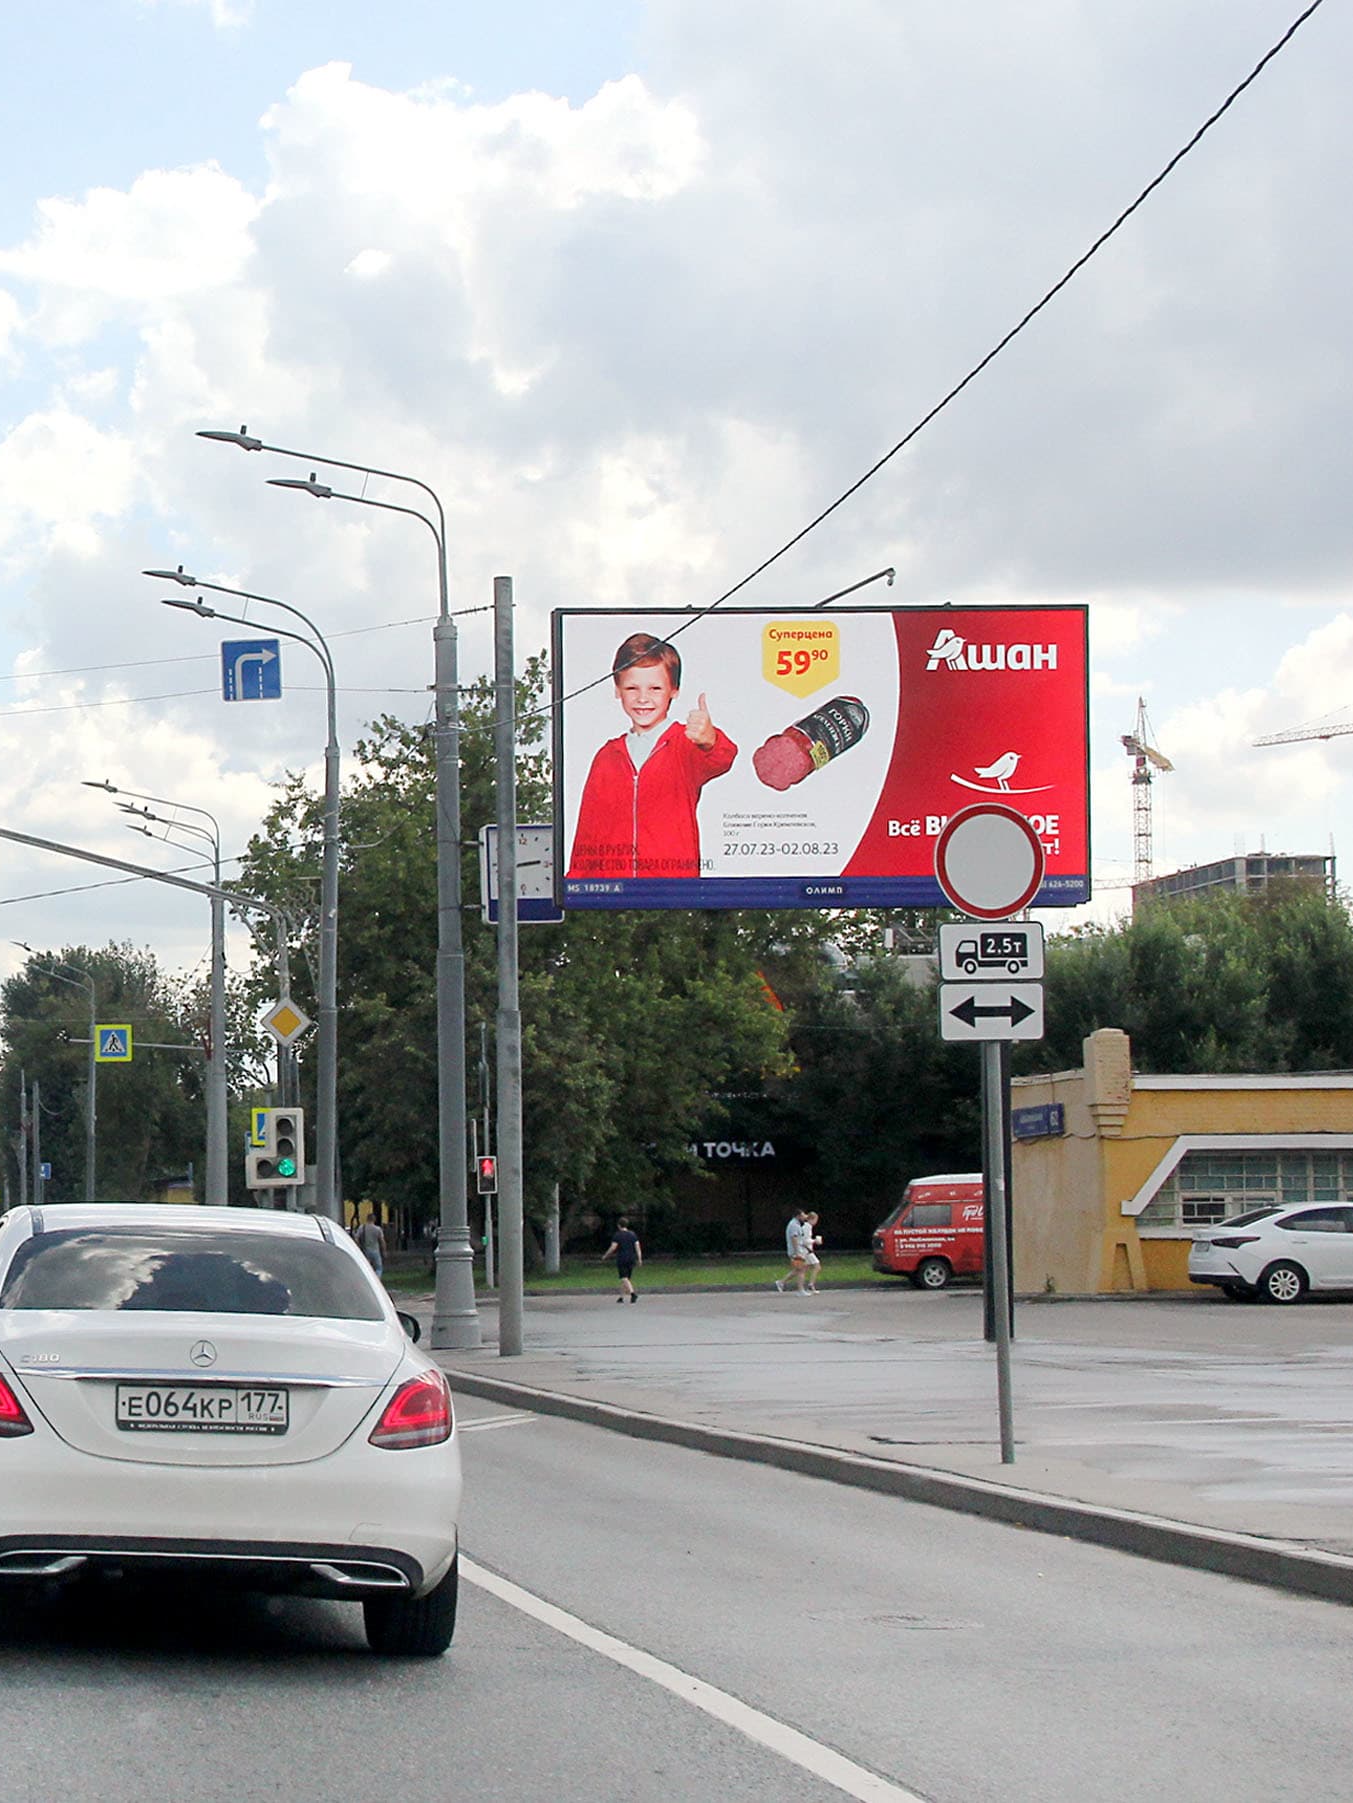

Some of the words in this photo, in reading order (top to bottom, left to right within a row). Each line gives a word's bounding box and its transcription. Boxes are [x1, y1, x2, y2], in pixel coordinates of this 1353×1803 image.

[769, 628, 833, 642] Суперцена
[925, 629, 1058, 671] Ашан
[888, 819, 921, 837] Всё
[723, 842, 839, 856] 27.07.23-02.08.23
[805, 886, 843, 895] ОЛИМП
[703, 1141, 776, 1158] ТОЧКА
[240, 1392, 281, 1413] 177
[248, 1413, 268, 1421] RUS
